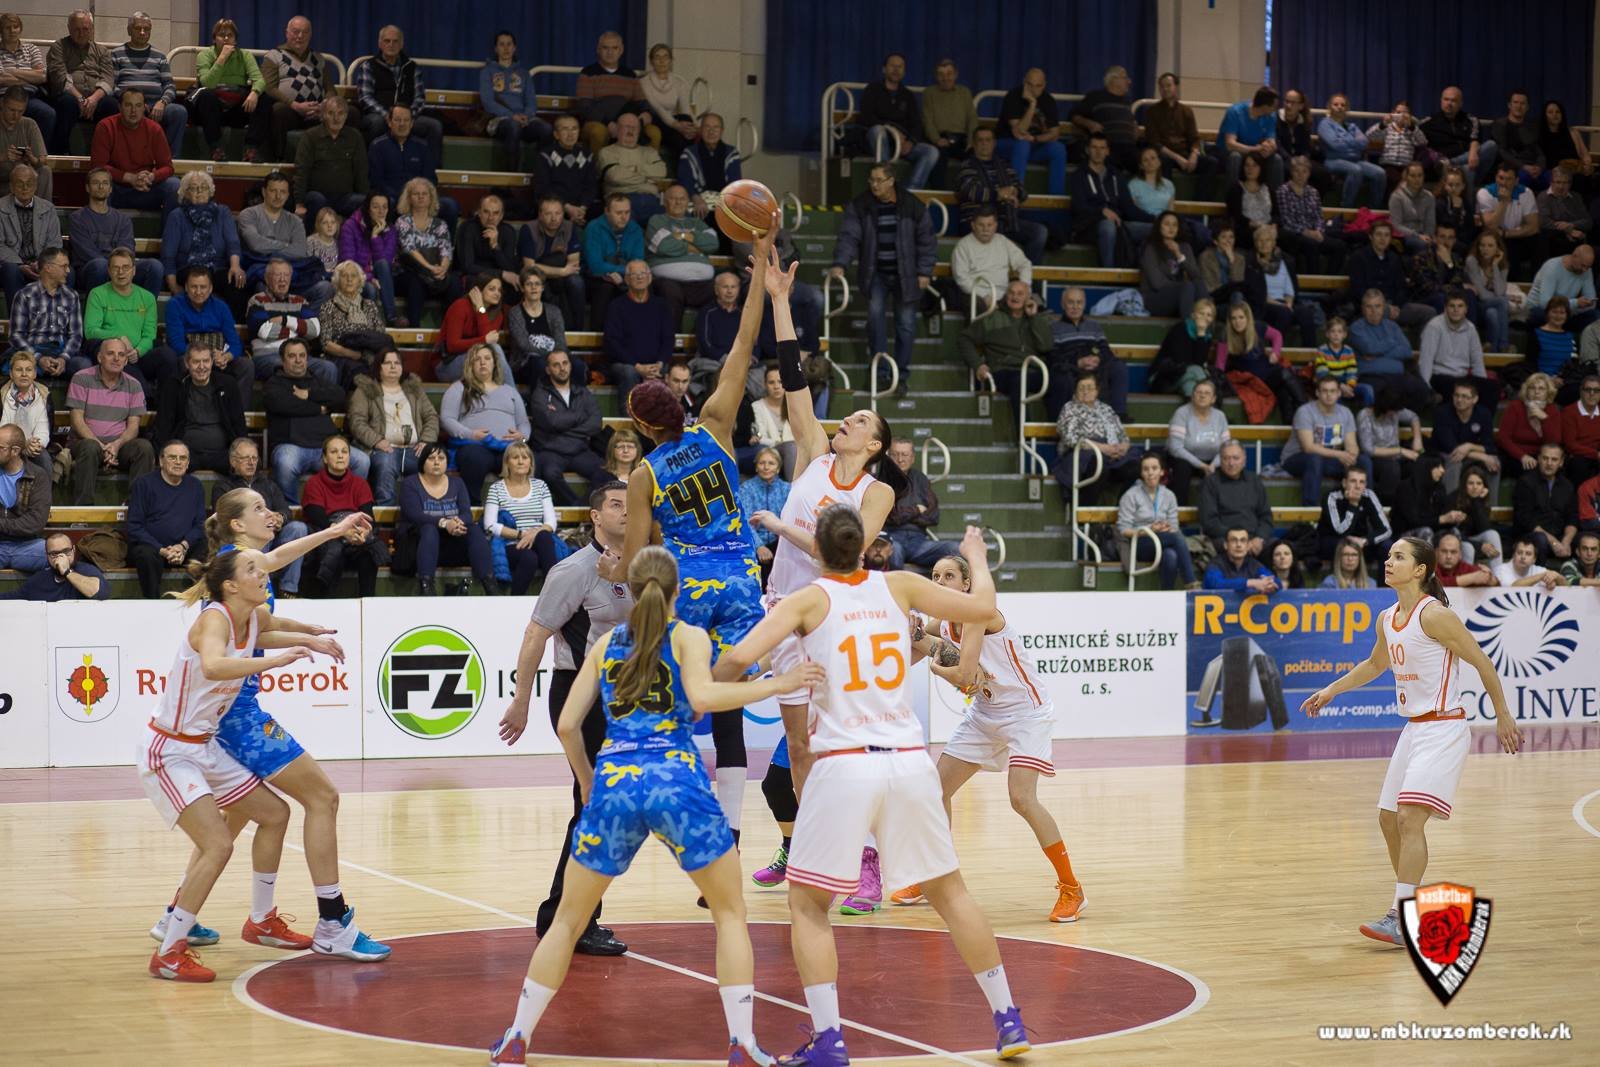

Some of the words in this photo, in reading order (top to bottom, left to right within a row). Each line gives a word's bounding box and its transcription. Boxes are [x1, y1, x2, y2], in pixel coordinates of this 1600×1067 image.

[666, 442, 705, 472] PARKER
[666, 460, 737, 528] 44
[1193, 594, 1372, 644] R-Comp
[1019, 629, 1109, 649] ECHNICKÉ
[1115, 628, 1179, 648] SLUŽBY
[838, 632, 906, 692] 15
[1037, 655, 1155, 674] RUŽOMBEROK
[1390, 644, 1405, 665] 10
[391, 654, 473, 710] FZ
[1081, 682, 1095, 695] a.
[1100, 682, 1112, 695] s.
